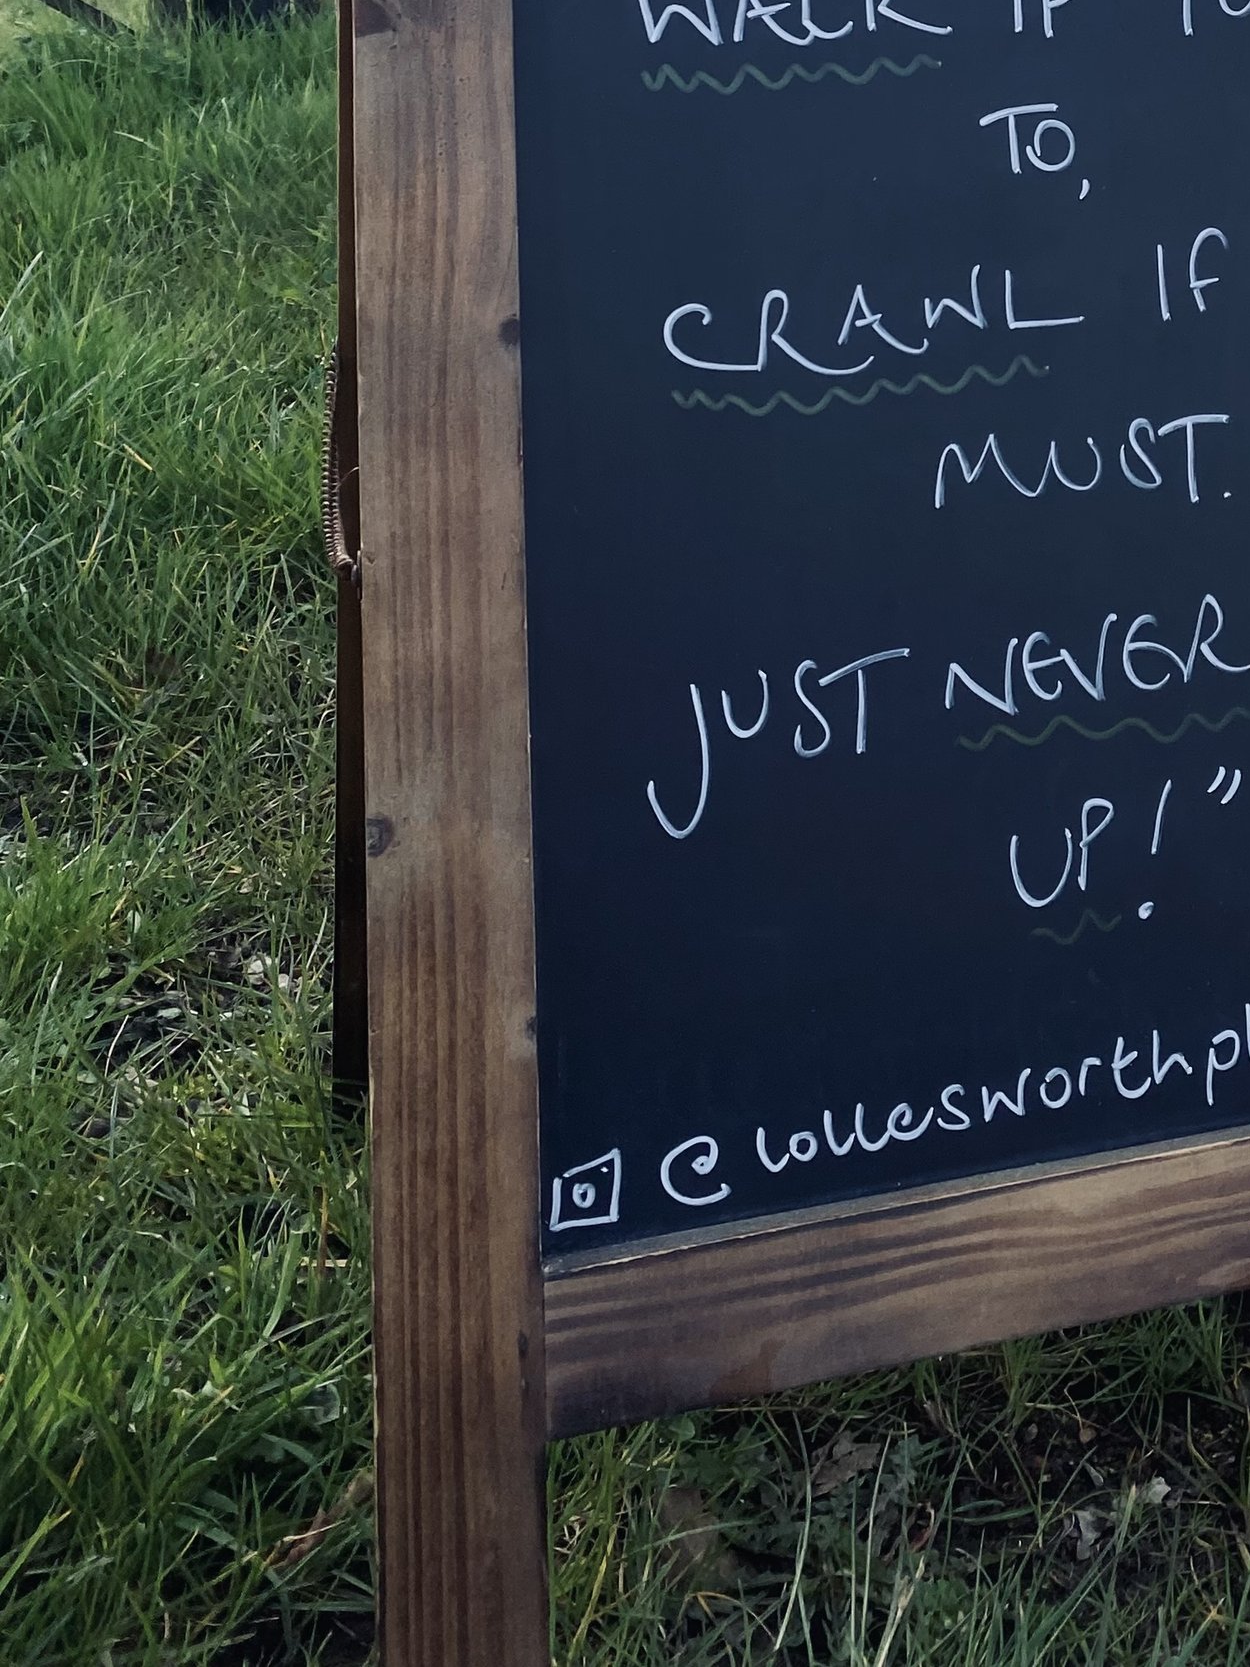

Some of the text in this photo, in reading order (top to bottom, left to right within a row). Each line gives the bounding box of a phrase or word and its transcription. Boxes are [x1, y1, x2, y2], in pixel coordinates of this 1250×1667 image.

[978, 102, 1091, 200] TO,
[663, 264, 1086, 376] CRAWL
[1156, 227, 1227, 322] IF
[934, 413, 1232, 509] MUST.
[646, 647, 911, 840] JUST
